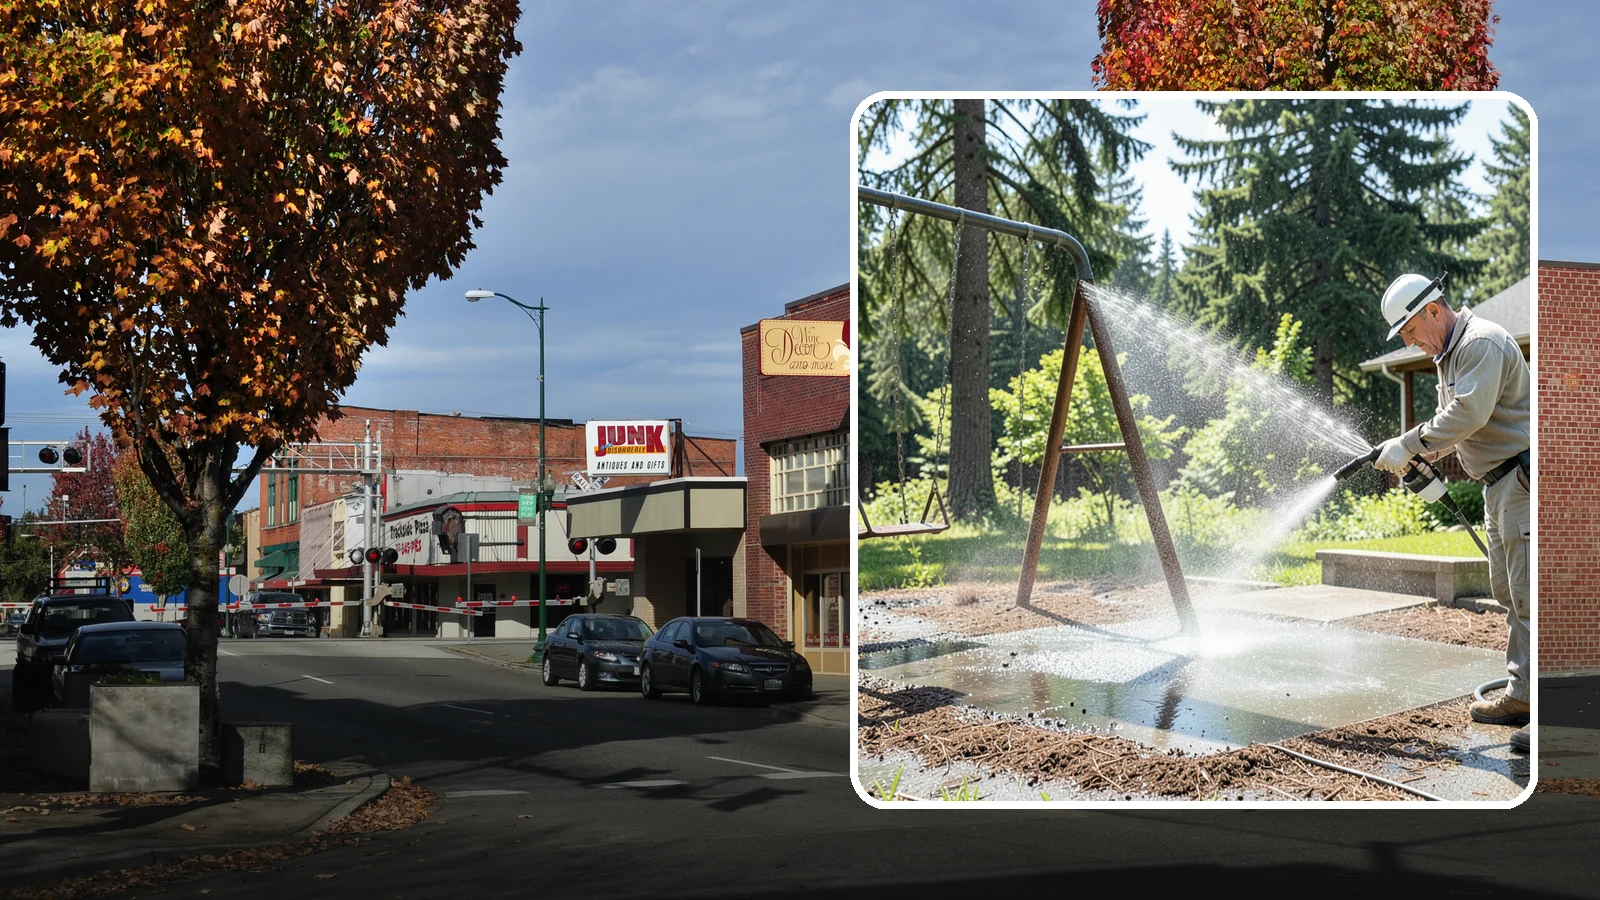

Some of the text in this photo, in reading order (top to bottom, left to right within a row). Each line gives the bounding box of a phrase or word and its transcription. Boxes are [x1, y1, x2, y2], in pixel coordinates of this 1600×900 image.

[764, 327, 831, 366] Decor
[595, 425, 666, 457] JUNK
[607, 446, 646, 454] DISORDERLY
[597, 460, 665, 470] ANTIQUES AND GIFTS
[390, 519, 429, 539] Trackside Pizza
